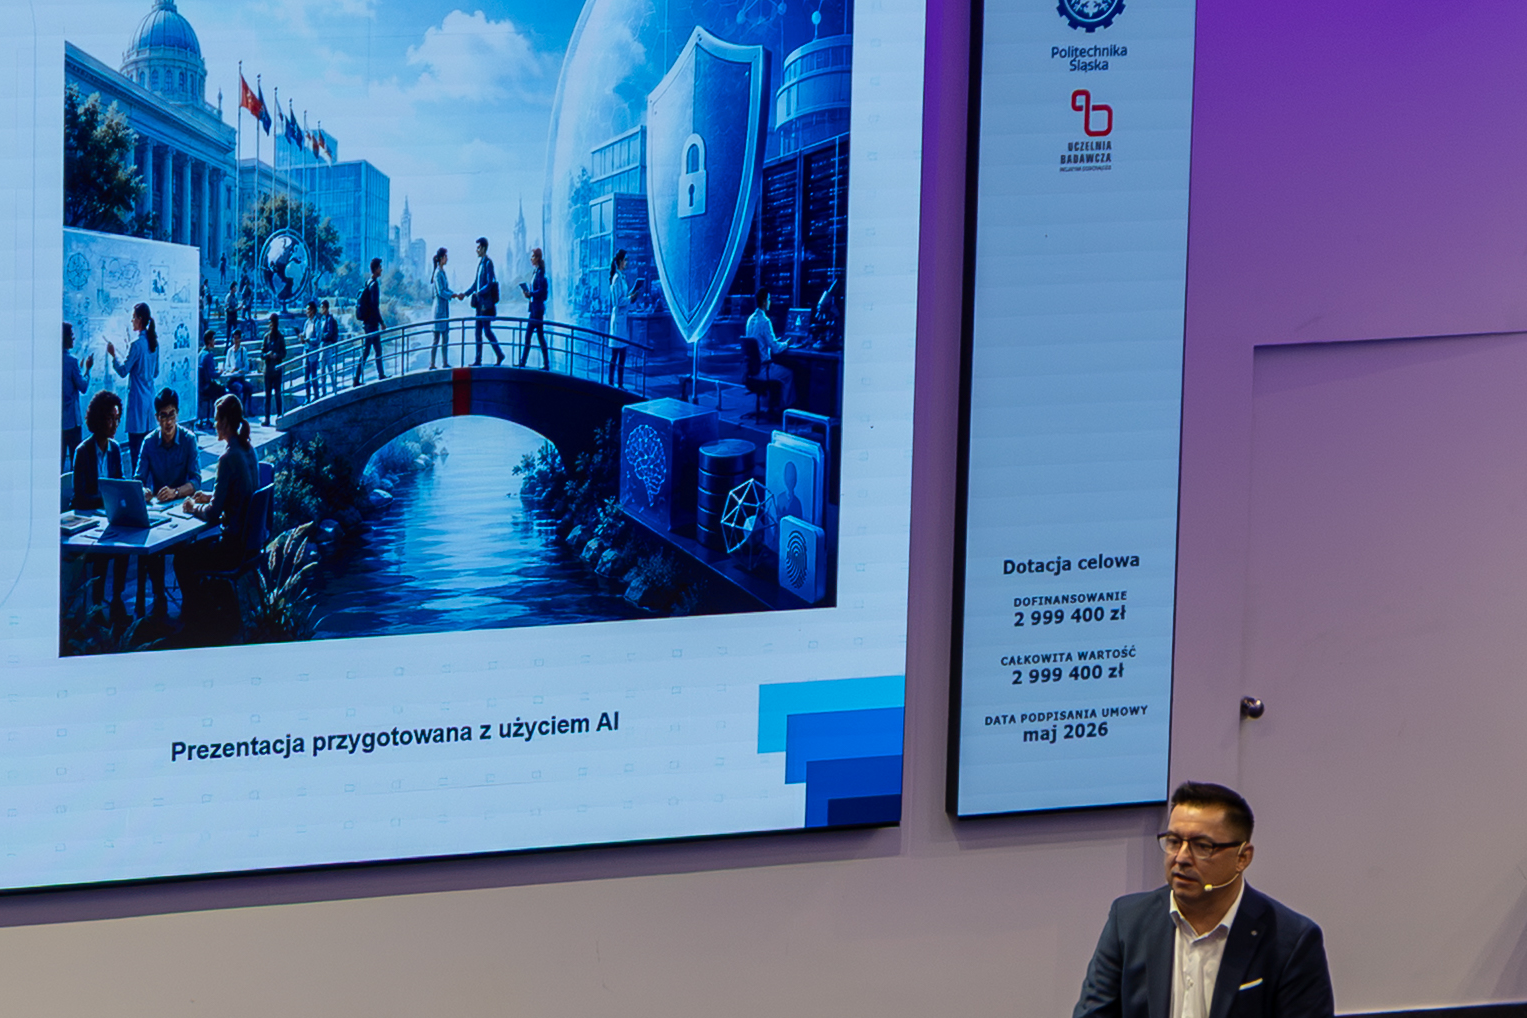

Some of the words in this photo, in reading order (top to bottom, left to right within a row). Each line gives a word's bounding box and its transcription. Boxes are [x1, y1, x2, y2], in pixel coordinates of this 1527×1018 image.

[1051, 44, 1128, 59] Politechnika
[1069, 57, 1109, 73] Śląska
[1068, 141, 1112, 152] UCZELNIA
[1060, 153, 1112, 165] BADAWCZA
[1003, 556, 1072, 576] Dotacja
[1078, 553, 1140, 571] celowa
[1013, 590, 1128, 608] DOFINANSOWANIE
[1014, 612, 1025, 627] 2
[1031, 609, 1064, 626] 999
[1070, 606, 1105, 623] 400
[1110, 605, 1126, 621] zł
[1000, 652, 1073, 667] CAŁKOWITA
[1077, 645, 1137, 662] WARTOŚĆ
[1012, 670, 1023, 685] 2
[1028, 667, 1062, 684] 999
[1068, 664, 1103, 681] 400
[1108, 662, 1124, 679] zł
[985, 714, 1017, 726] DATA
[1021, 708, 1097, 724] PODPISANIA
[1101, 705, 1149, 718] UMOWY
[171, 732, 305, 762] Prezentacja
[312, 723, 473, 757] przygotowana
[479, 721, 491, 740] z
[498, 715, 591, 743] użyciem
[596, 711, 620, 732] AI
[1023, 724, 1057, 744] maj
[1063, 721, 1109, 740] 2026
